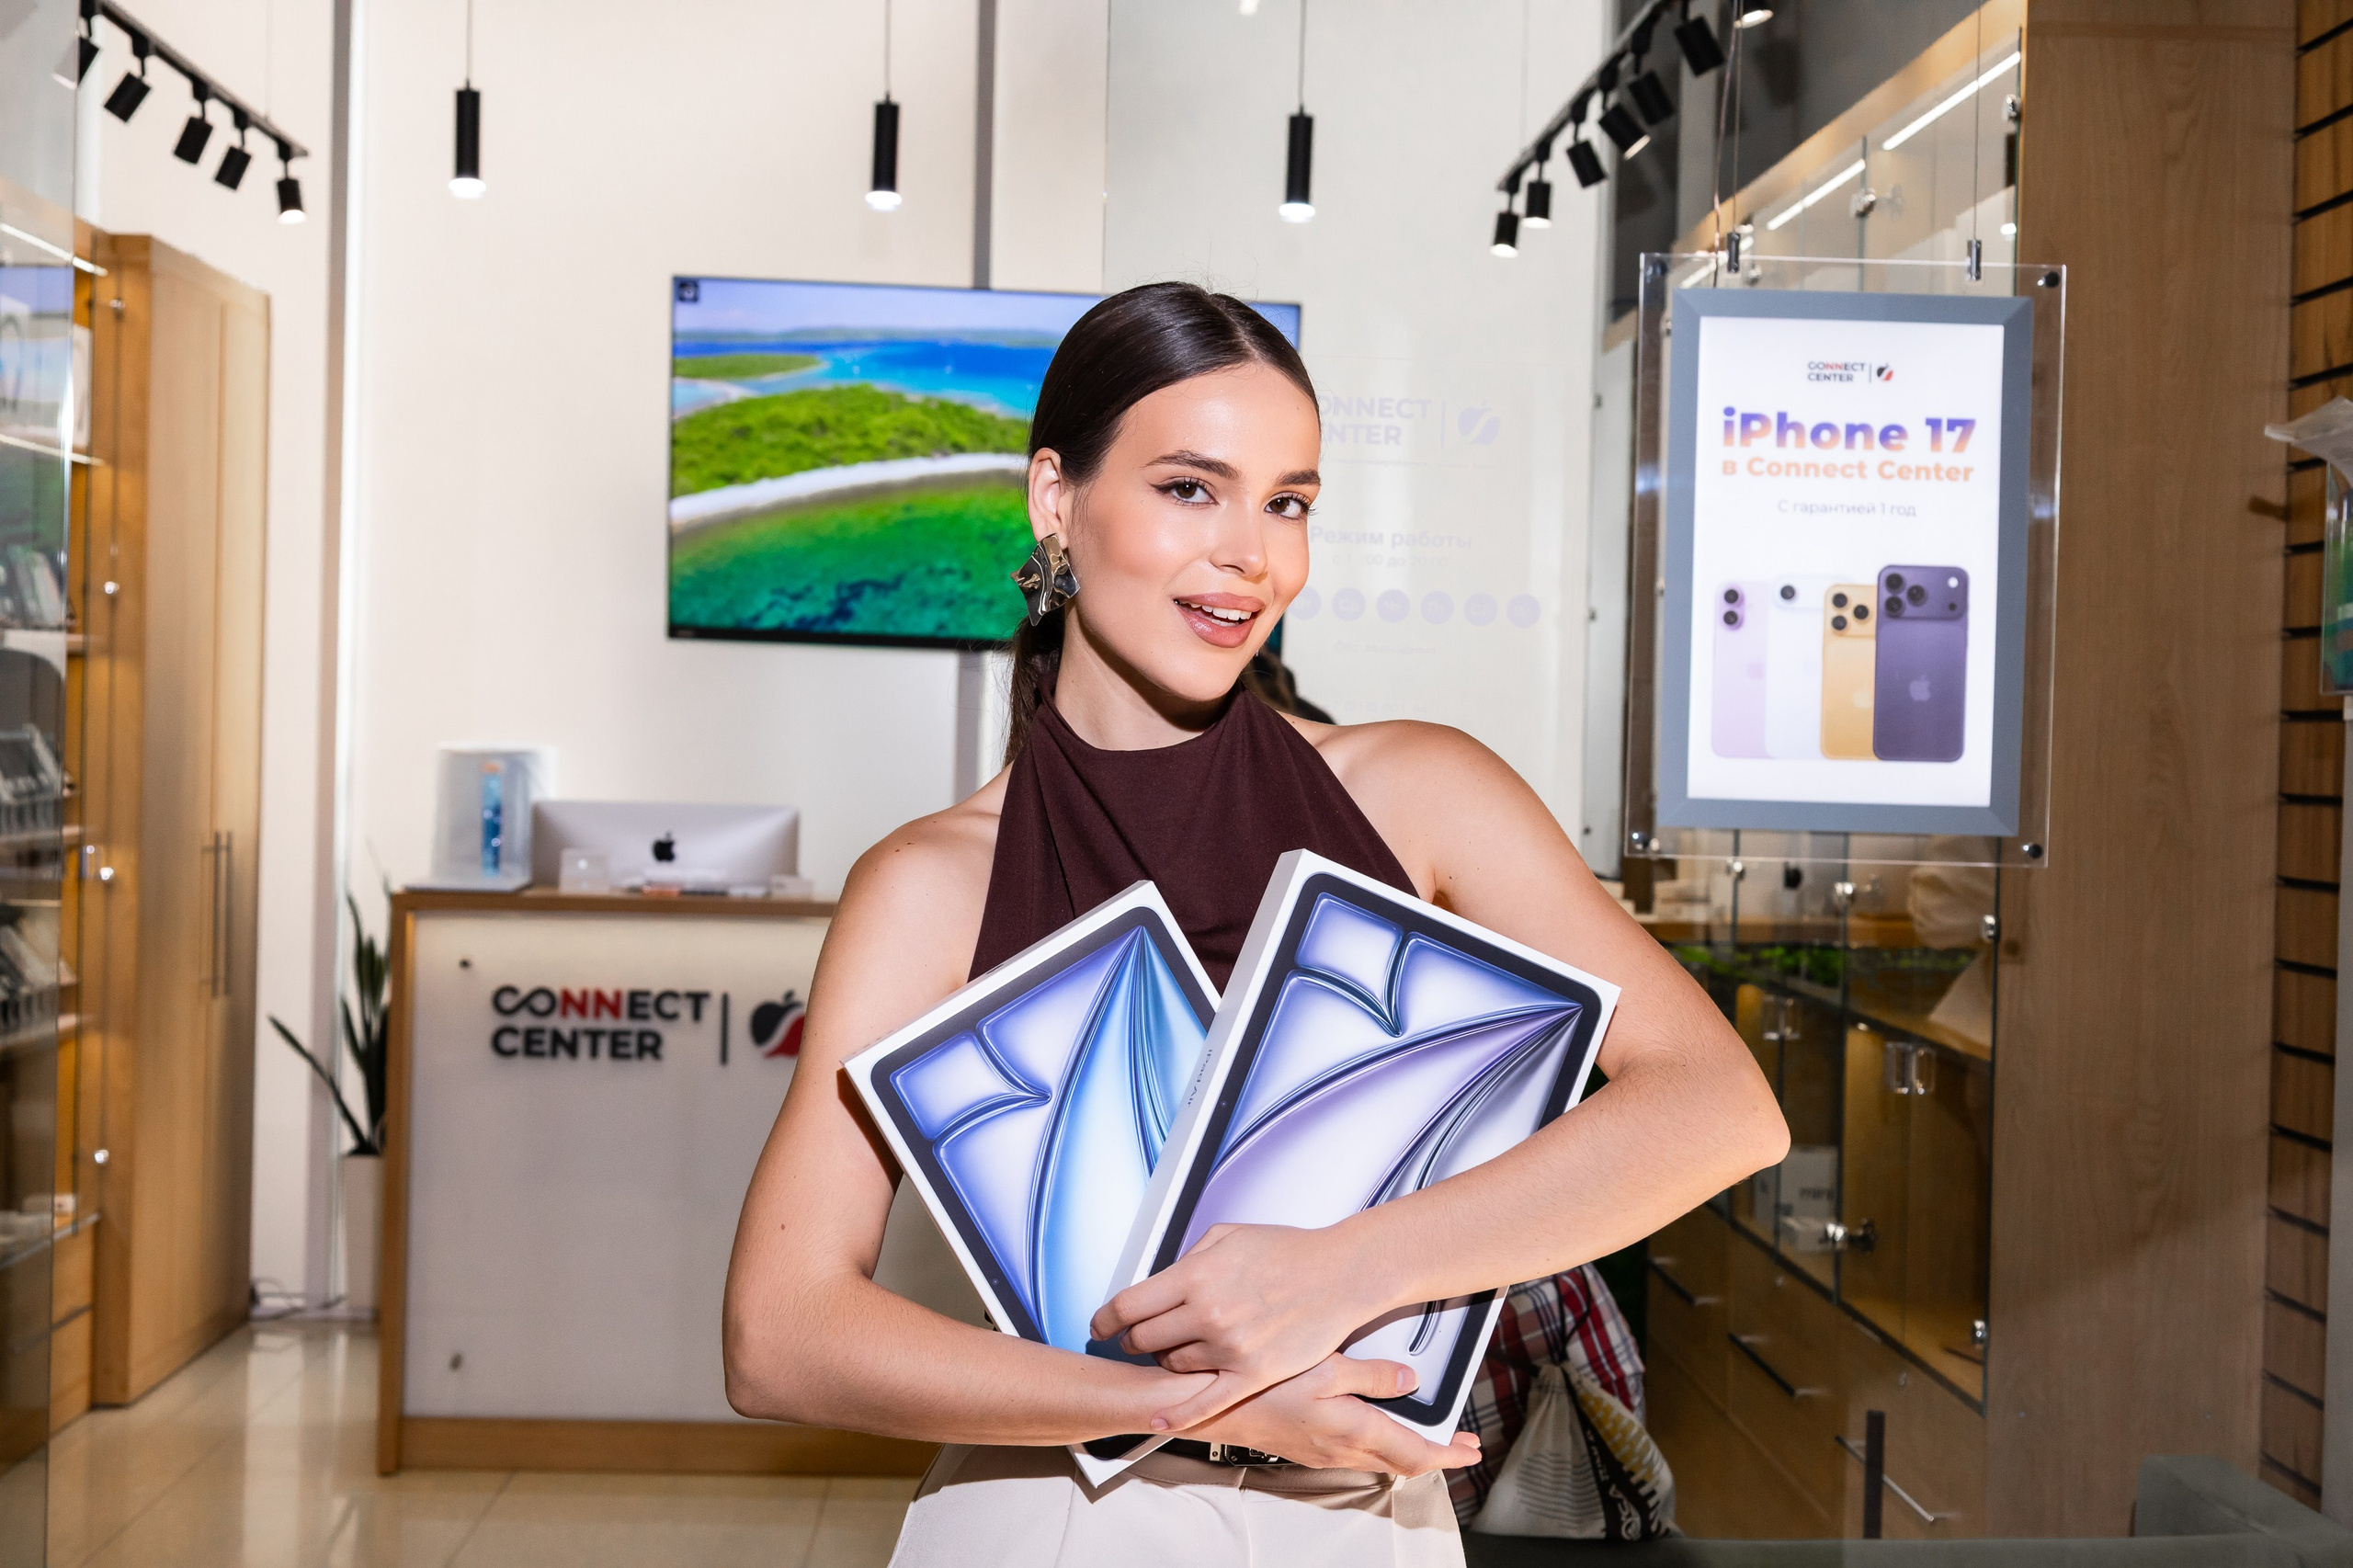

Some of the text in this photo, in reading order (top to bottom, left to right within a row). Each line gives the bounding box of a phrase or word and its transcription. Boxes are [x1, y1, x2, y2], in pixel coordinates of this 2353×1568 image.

[1808, 361, 1866, 371] CONNECT
[1808, 372, 1854, 382] CENTER
[1318, 395, 1433, 419] ONNECT
[1324, 423, 1403, 445] NTER
[1722, 406, 1976, 452] iPhone 17
[1746, 457, 1867, 479] Connect
[1878, 460, 1973, 482] Center
[1793, 502, 1877, 515] гарантией
[1890, 505, 1916, 517] год
[1311, 525, 1472, 550] Режим работы
[491, 985, 710, 1023] CONNECT
[491, 1025, 663, 1060] CENTER
[1187, 1049, 1213, 1108] iPad Air
